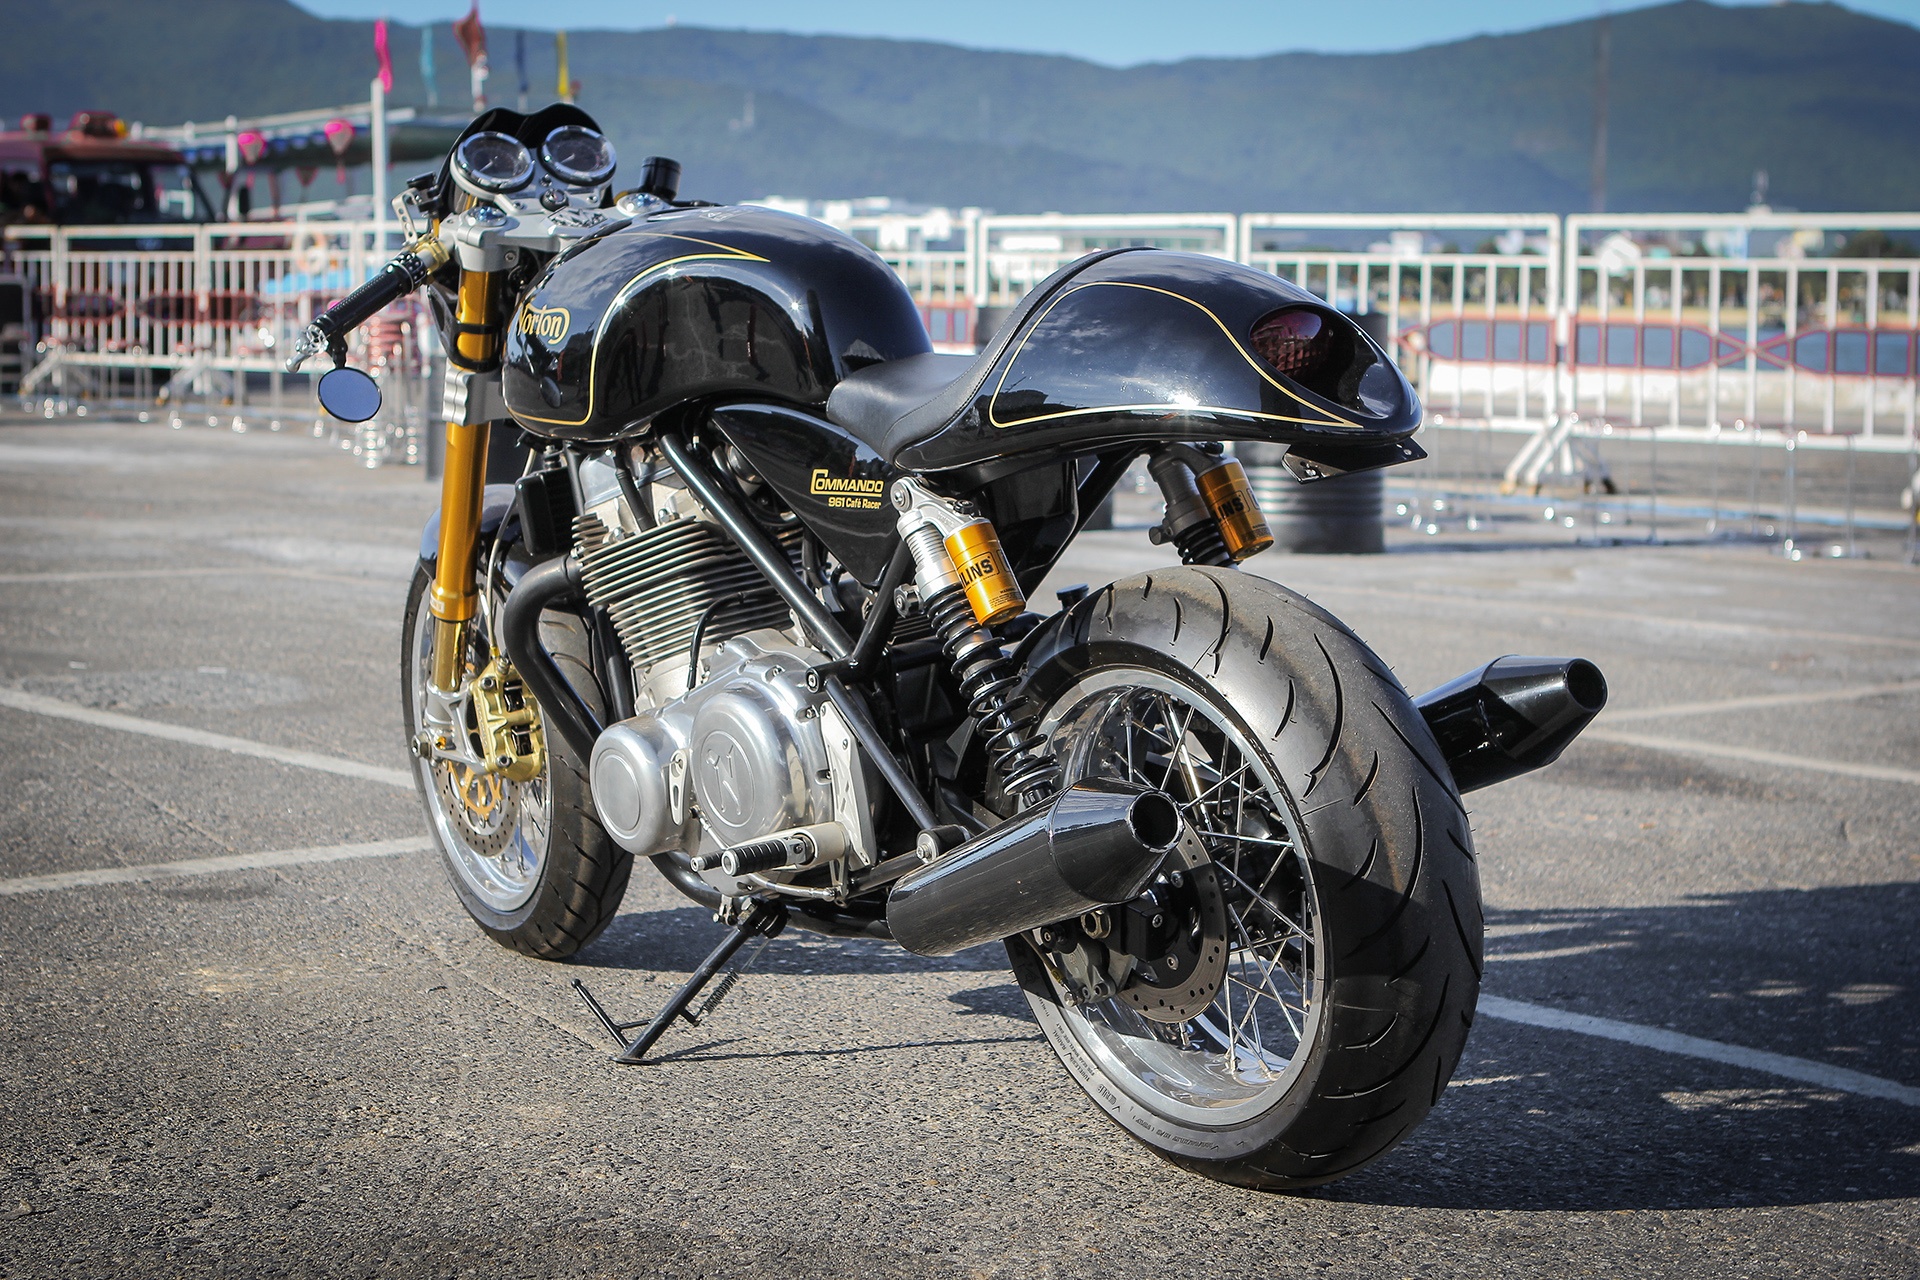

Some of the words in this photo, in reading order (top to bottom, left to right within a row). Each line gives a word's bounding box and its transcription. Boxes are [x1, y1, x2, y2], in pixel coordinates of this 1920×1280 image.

[516, 302, 571, 345] Norton
[828, 497, 846, 508] 961
[846, 498, 861, 508] Café
[862, 499, 881, 509] Racer
